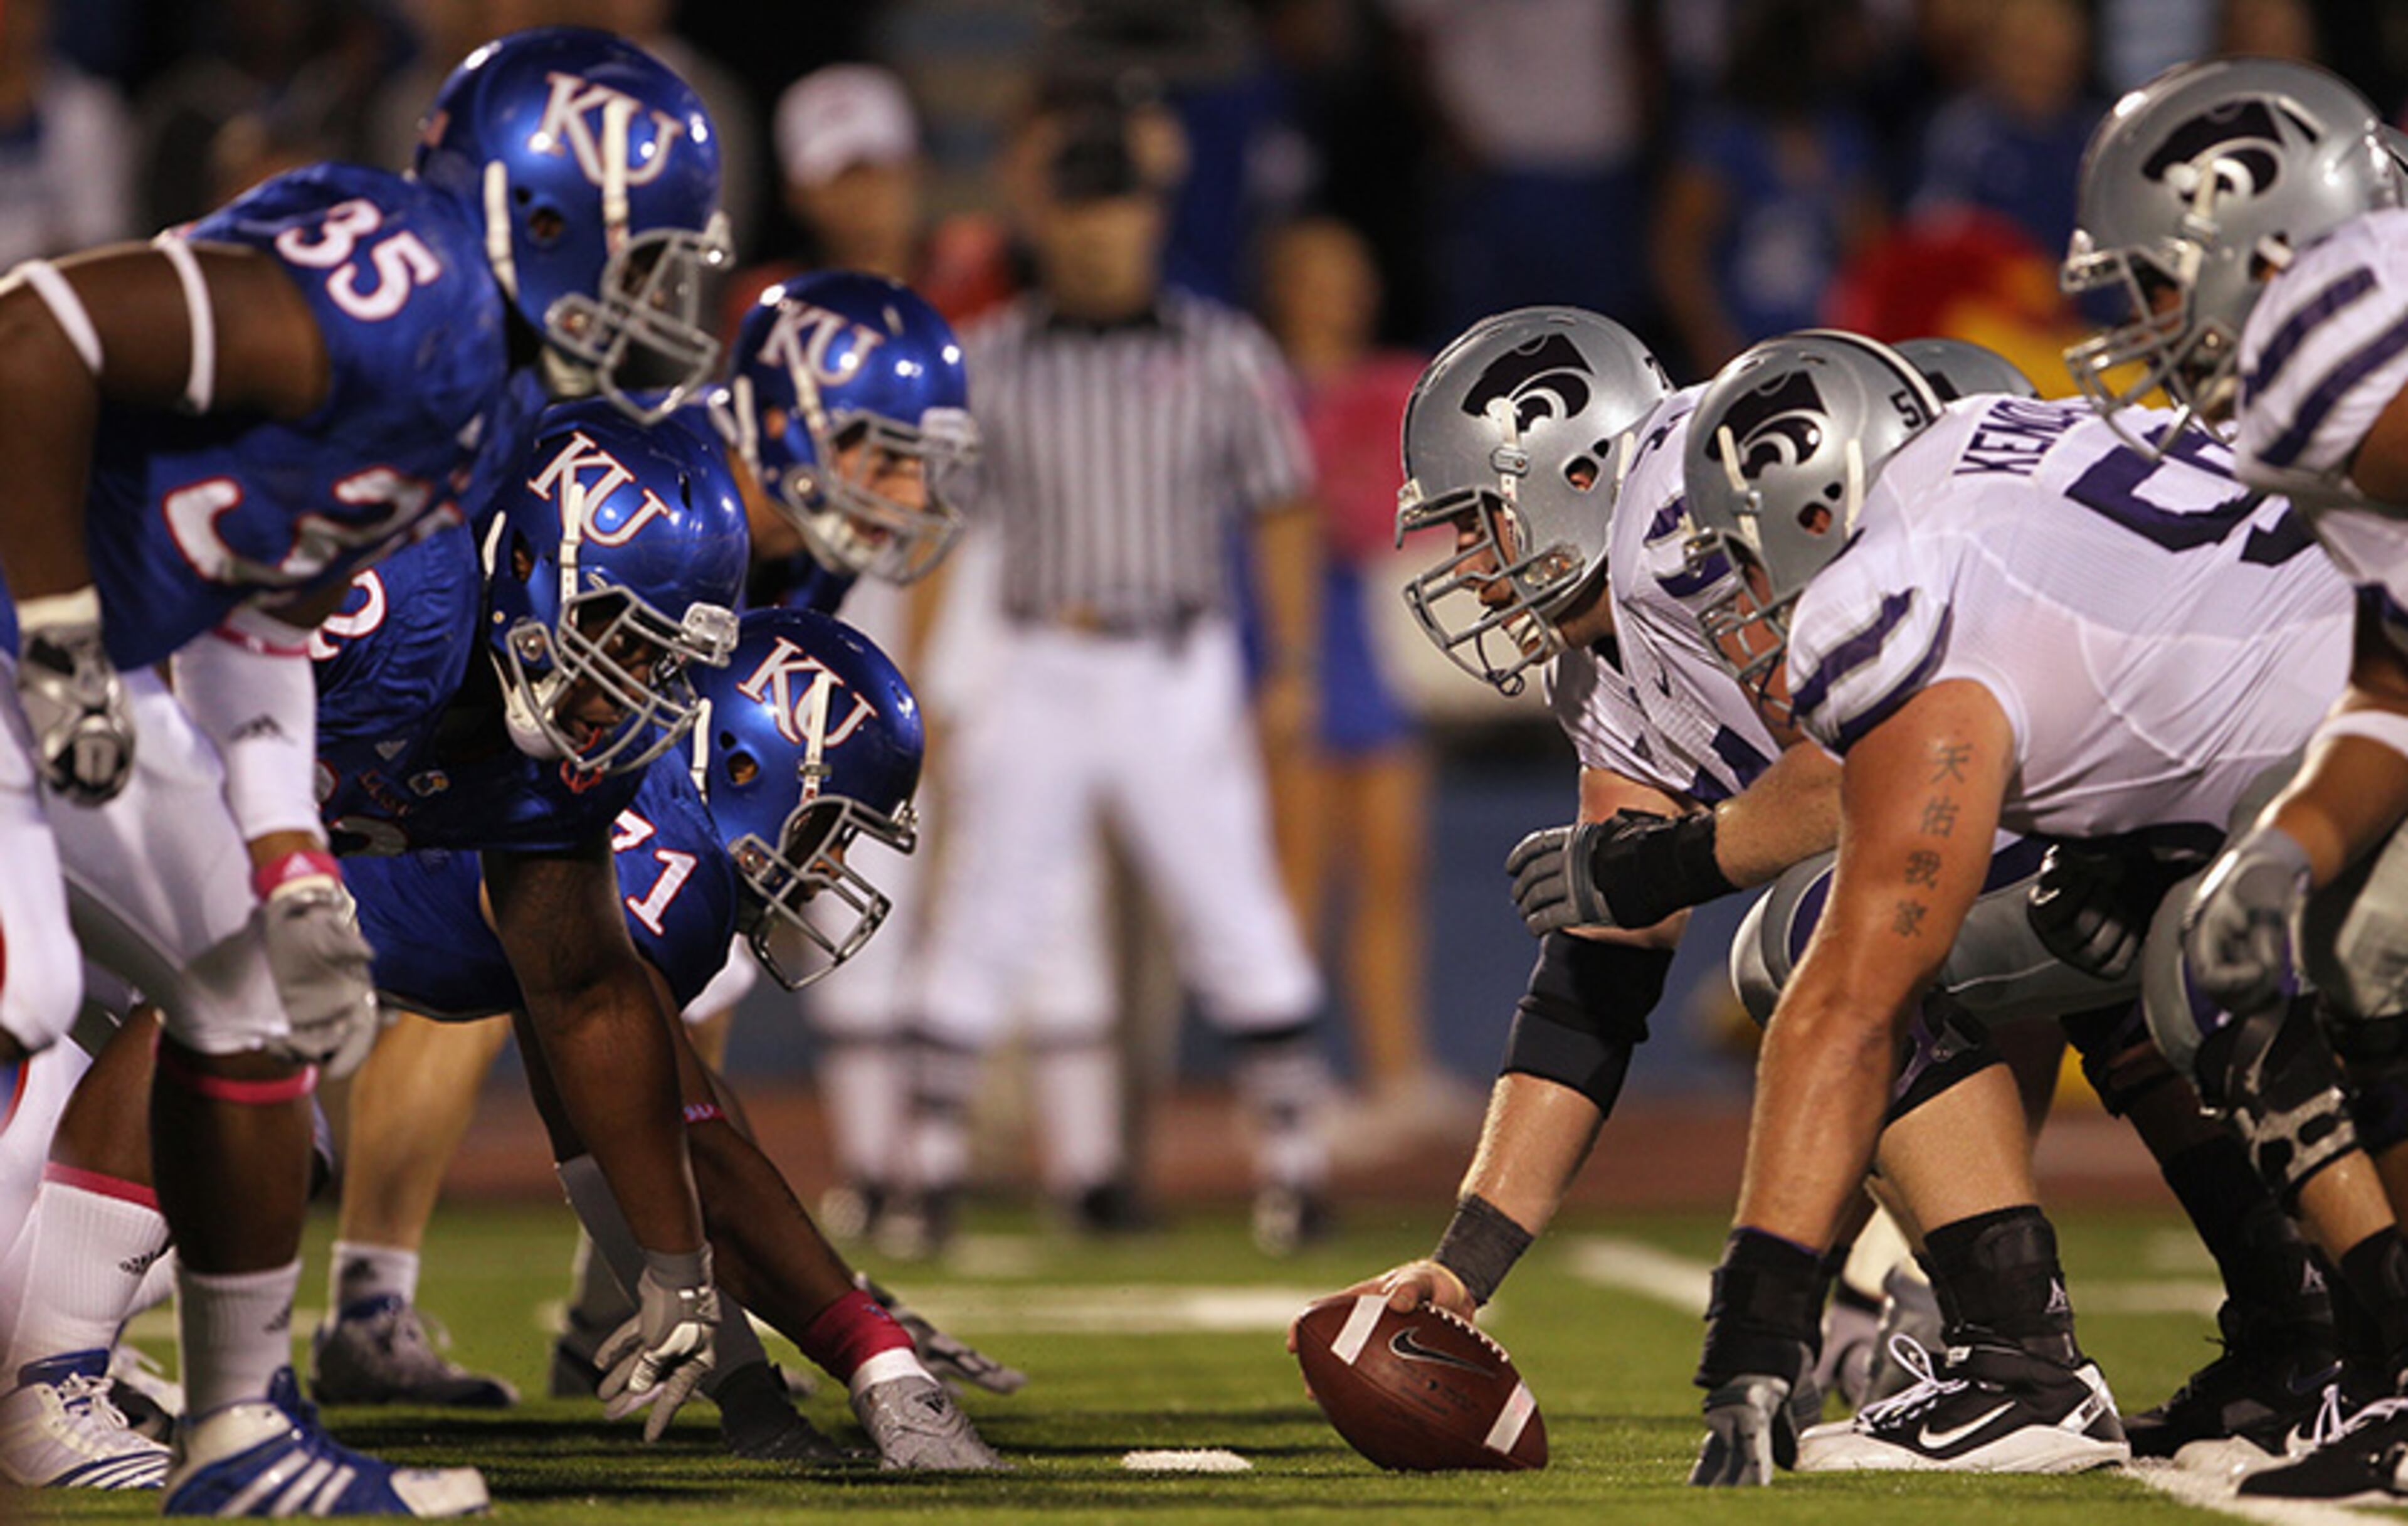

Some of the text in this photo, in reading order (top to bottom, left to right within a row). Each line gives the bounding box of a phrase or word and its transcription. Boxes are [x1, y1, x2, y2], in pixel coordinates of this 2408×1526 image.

[529, 70, 685, 186] KU
[274, 197, 441, 322] 35
[757, 297, 885, 387] KU
[1889, 389, 1921, 429] 5
[527, 432, 671, 548] KU
[736, 636, 877, 748] KU
